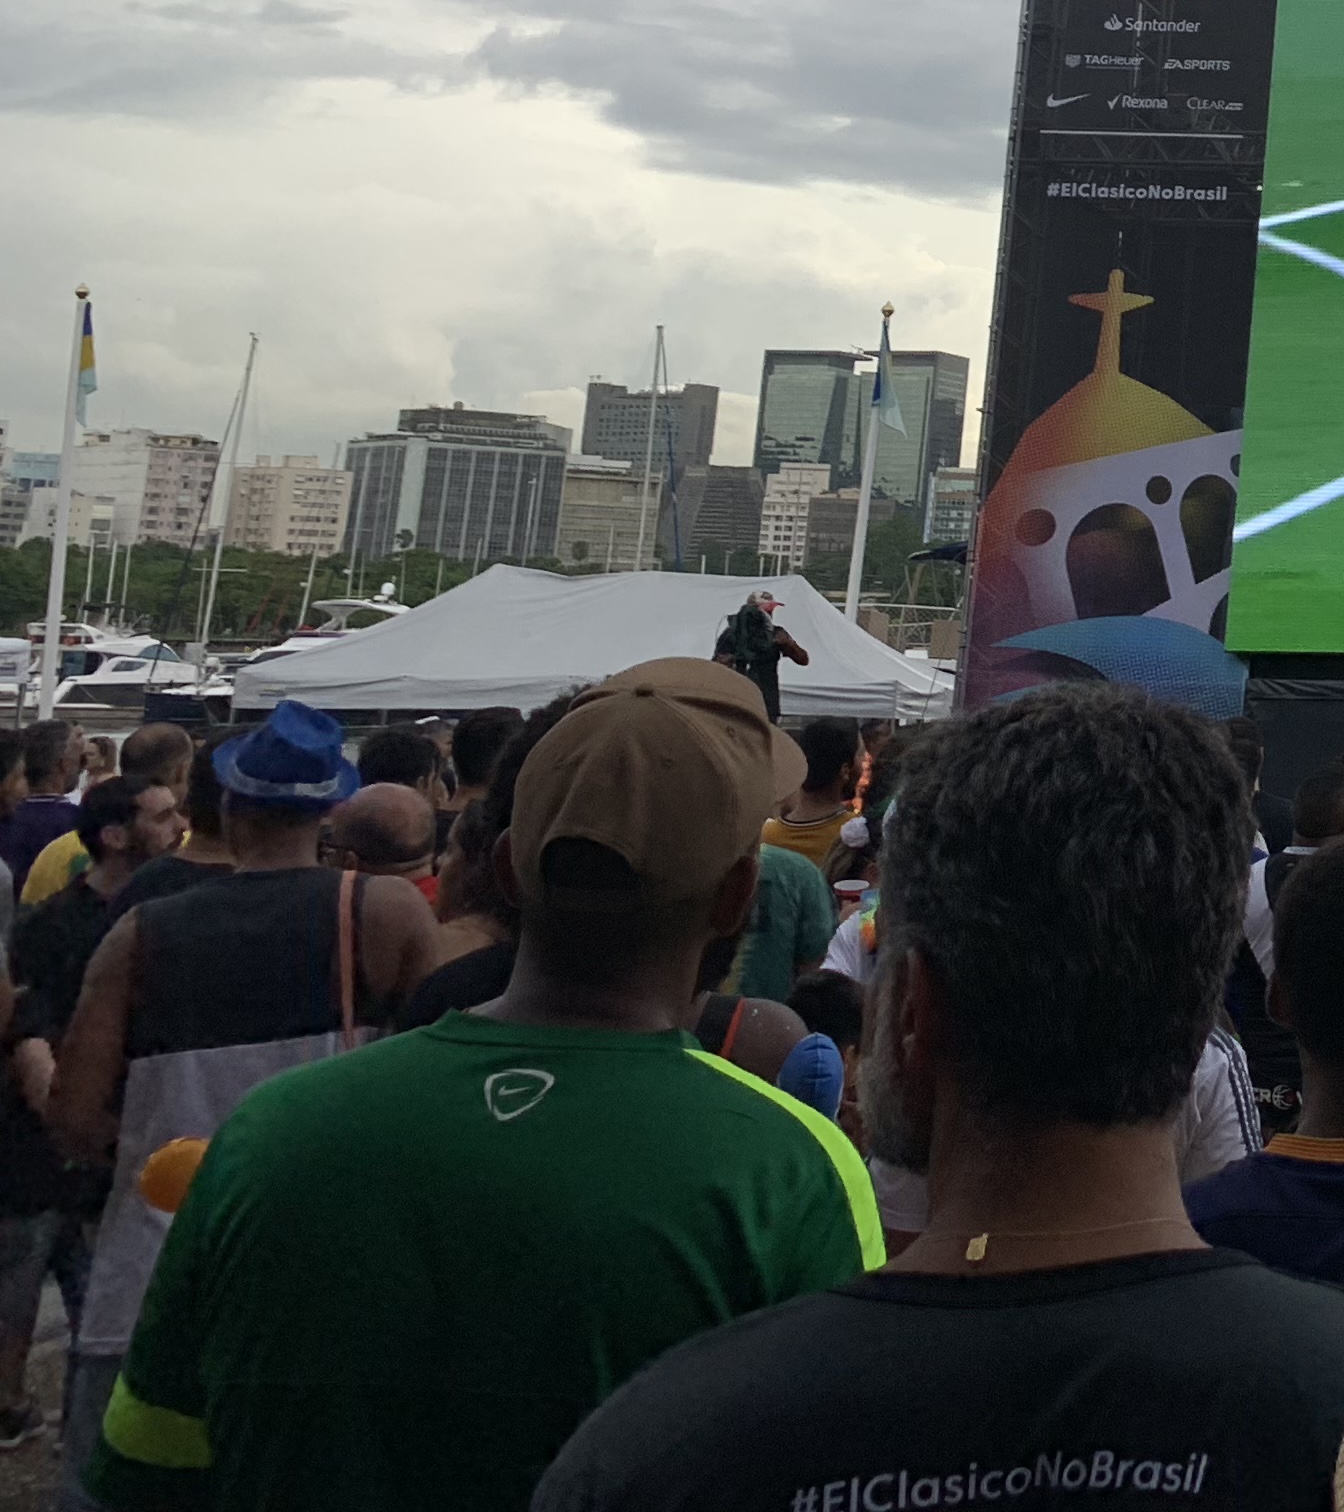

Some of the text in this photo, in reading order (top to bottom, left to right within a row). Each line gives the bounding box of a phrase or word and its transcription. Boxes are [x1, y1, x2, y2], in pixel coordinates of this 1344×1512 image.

[1124, 17, 1201, 33] Santander
[1121, 95, 1169, 110] Rexona
[1046, 182, 1228, 201] #ElClasicoNoBrasil
[789, 1449, 1208, 1512] #ElClasicoNoBrasil
